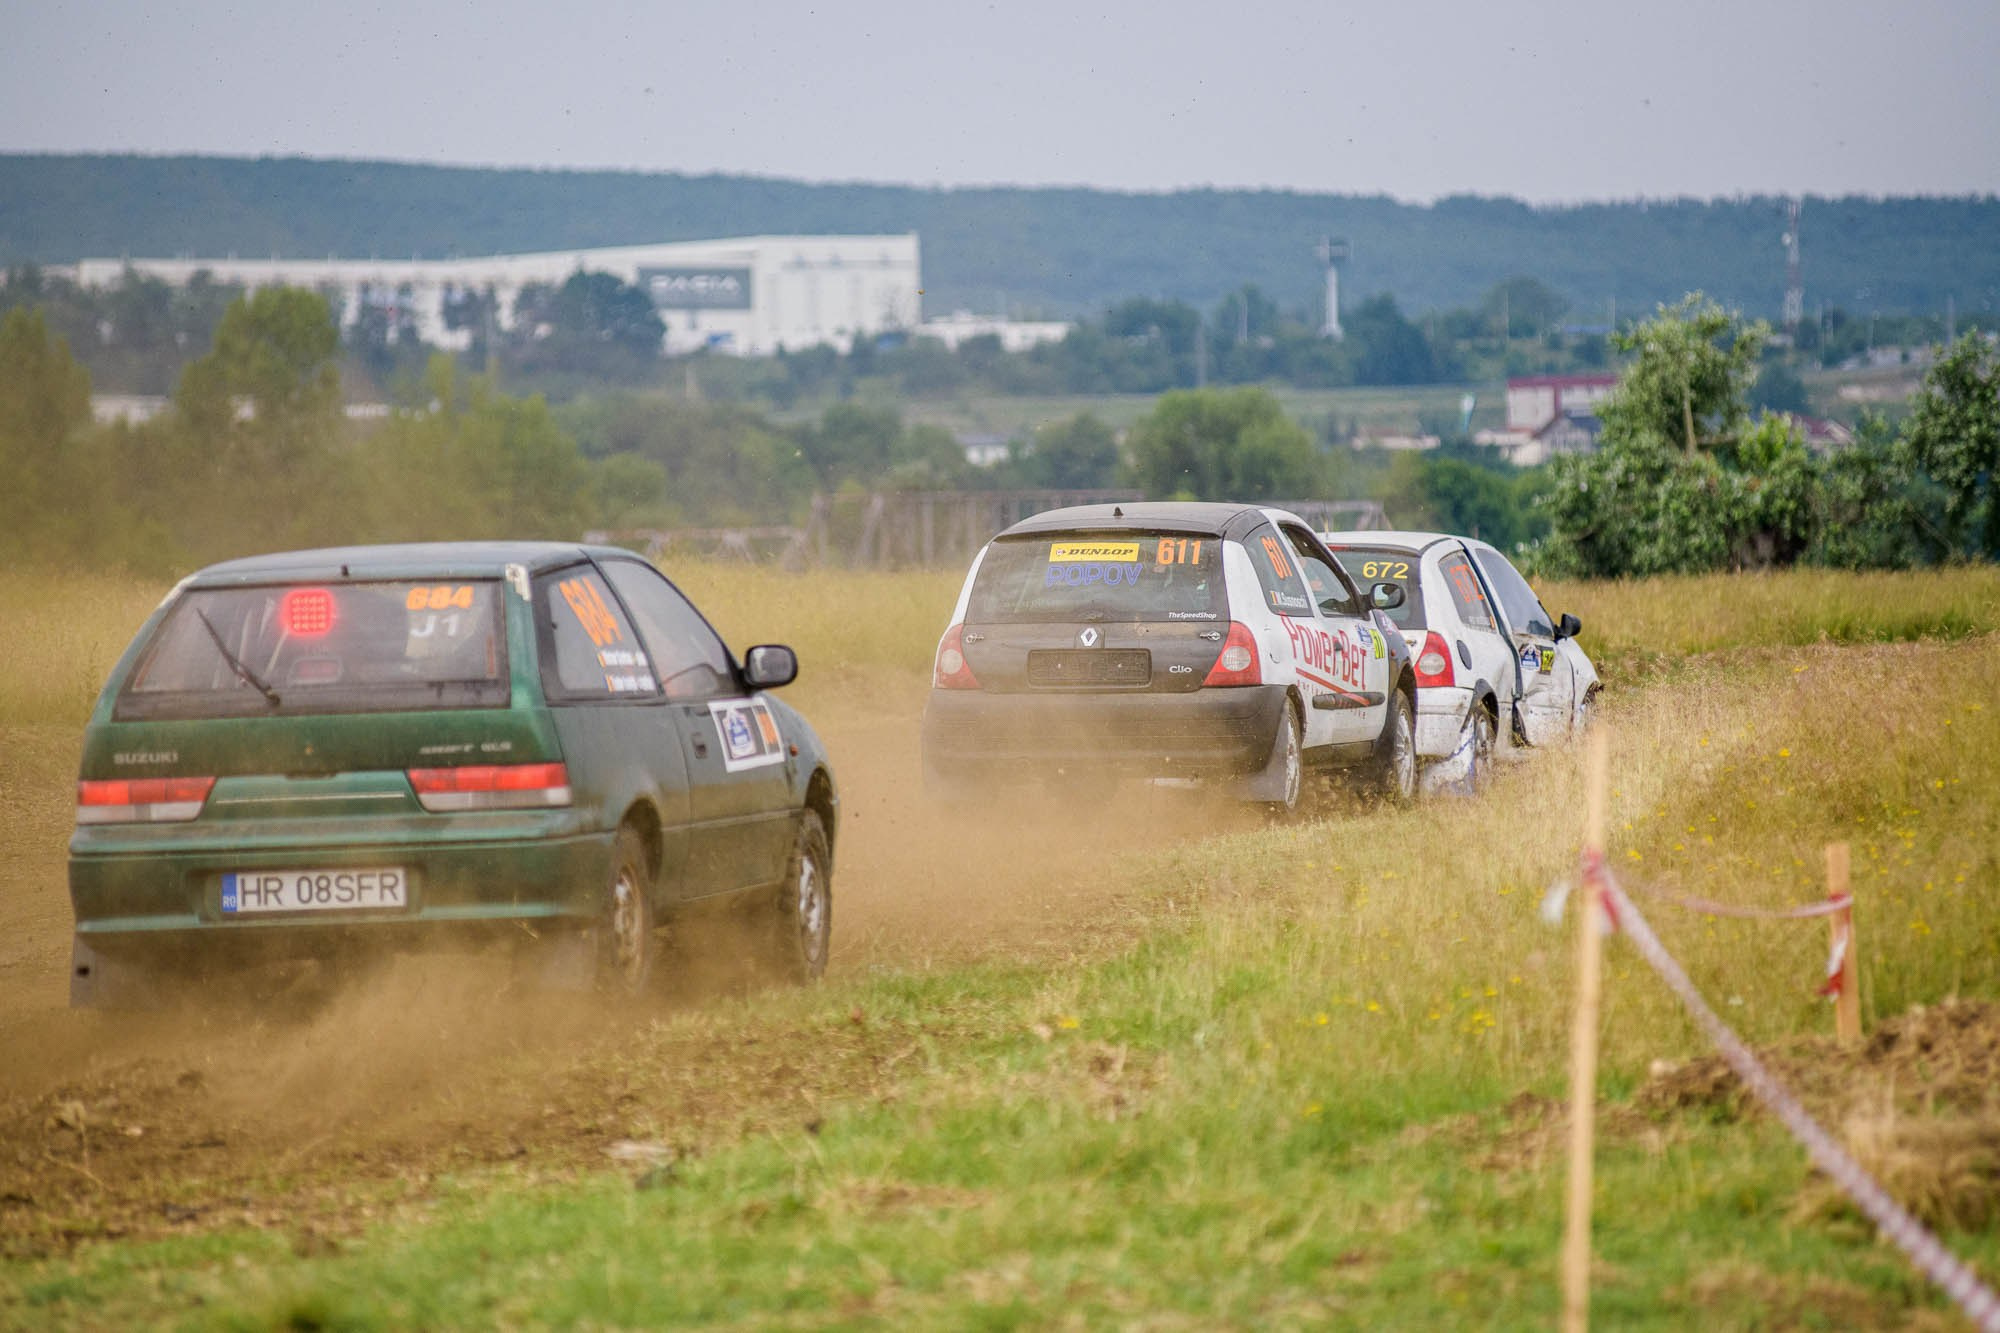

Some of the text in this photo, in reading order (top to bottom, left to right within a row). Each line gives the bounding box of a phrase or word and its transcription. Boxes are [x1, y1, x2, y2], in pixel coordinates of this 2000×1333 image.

[1068, 548, 1134, 556] DUNLOP
[1157, 540, 1201, 565] 611
[1046, 562, 1144, 588] POPOV
[1362, 561, 1409, 579] 672
[1168, 611, 1217, 620] TheSpeedShop
[1169, 664, 1192, 673] Clio
[113, 751, 178, 765] SUZUKI
[240, 877, 283, 907] HR
